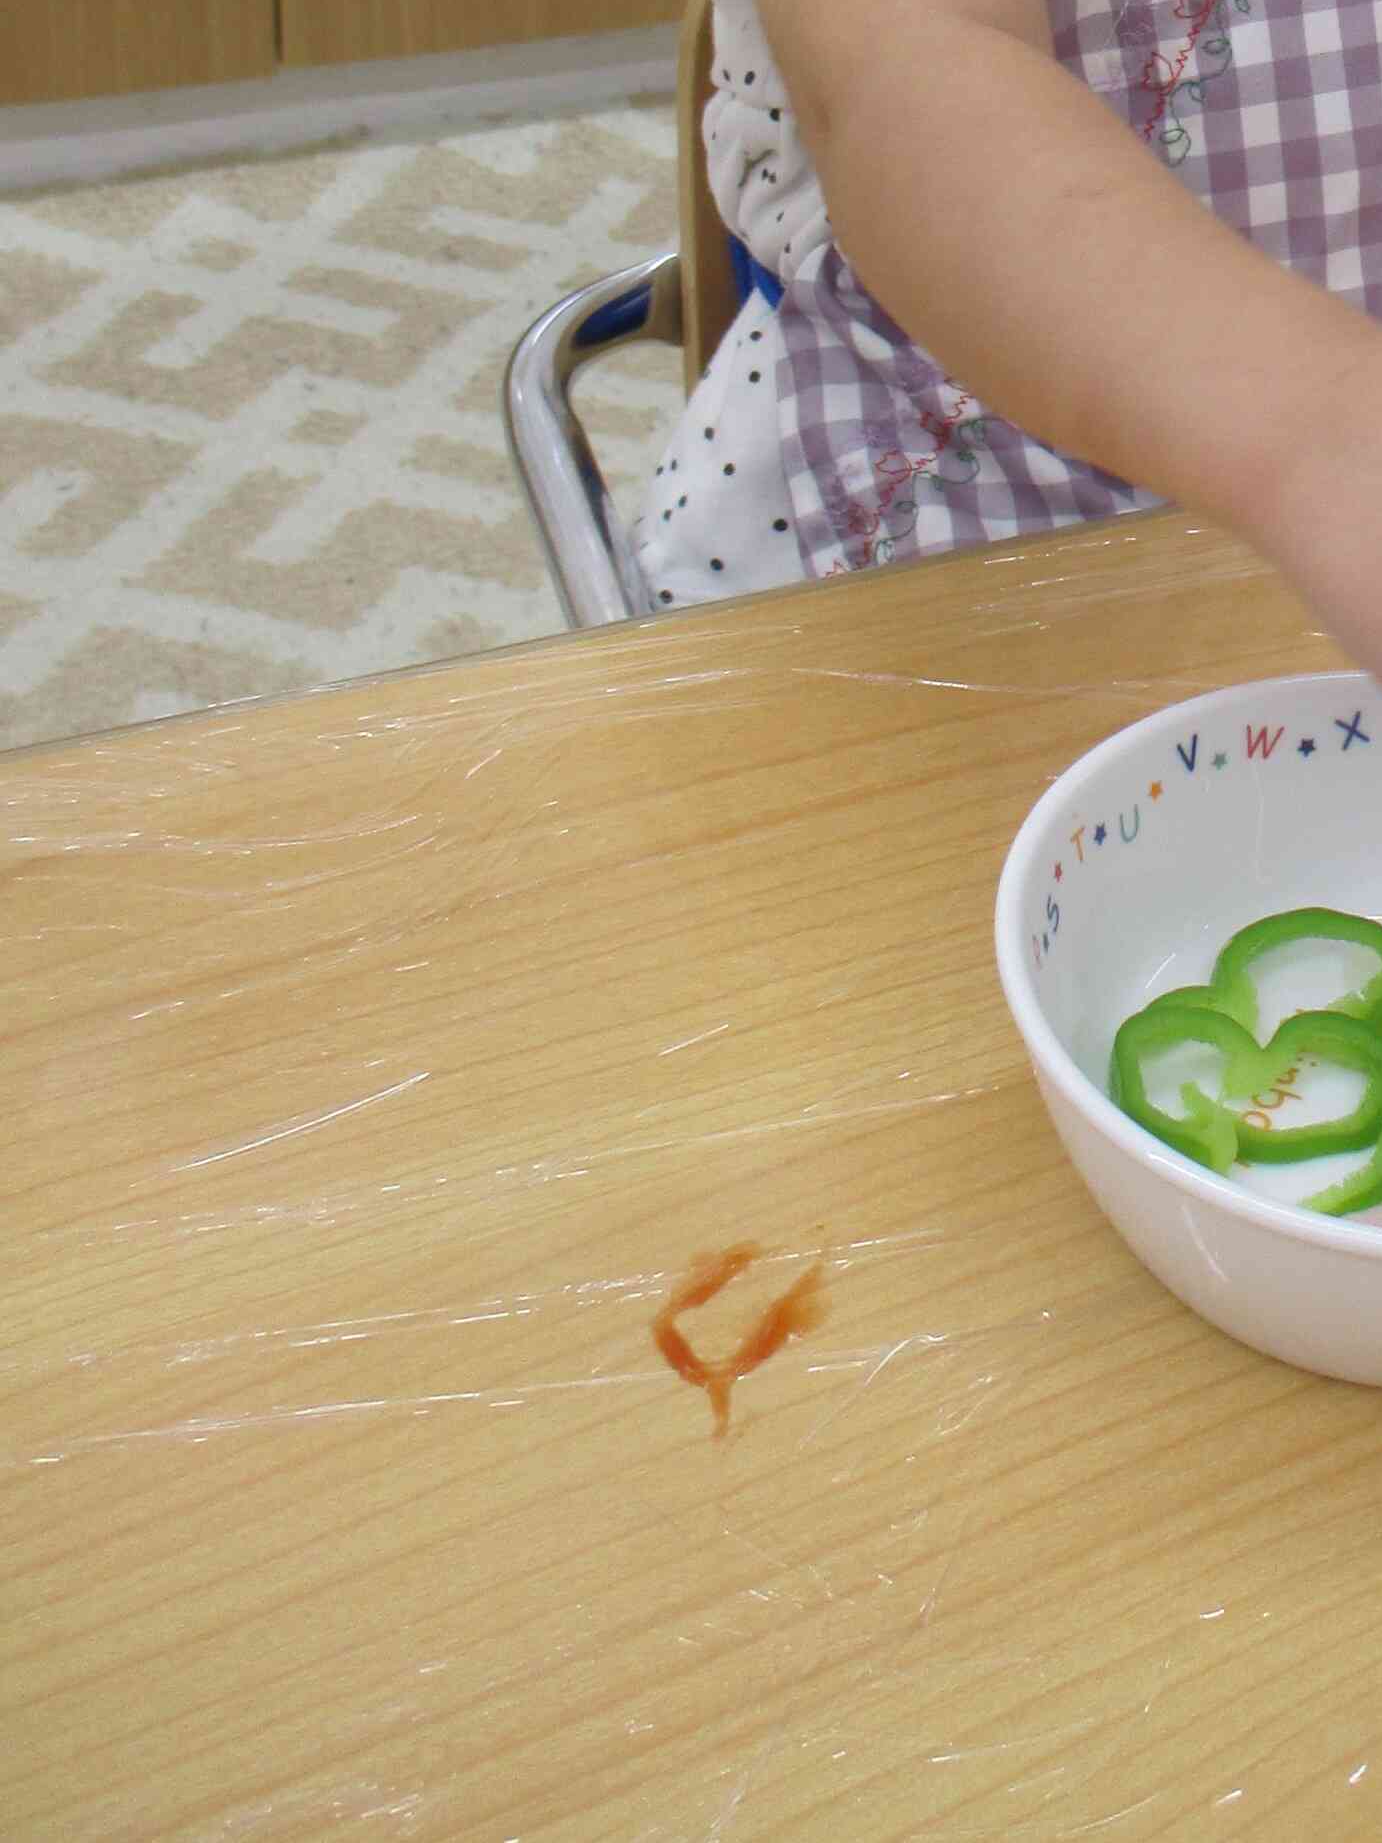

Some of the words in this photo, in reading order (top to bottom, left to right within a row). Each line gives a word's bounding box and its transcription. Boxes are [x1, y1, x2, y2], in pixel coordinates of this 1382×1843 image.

[1070, 825, 1085, 863] T
[1119, 804, 1140, 843] U
[1176, 733, 1198, 772] V
[1246, 723, 1285, 760] W
[1334, 711, 1370, 751] X
